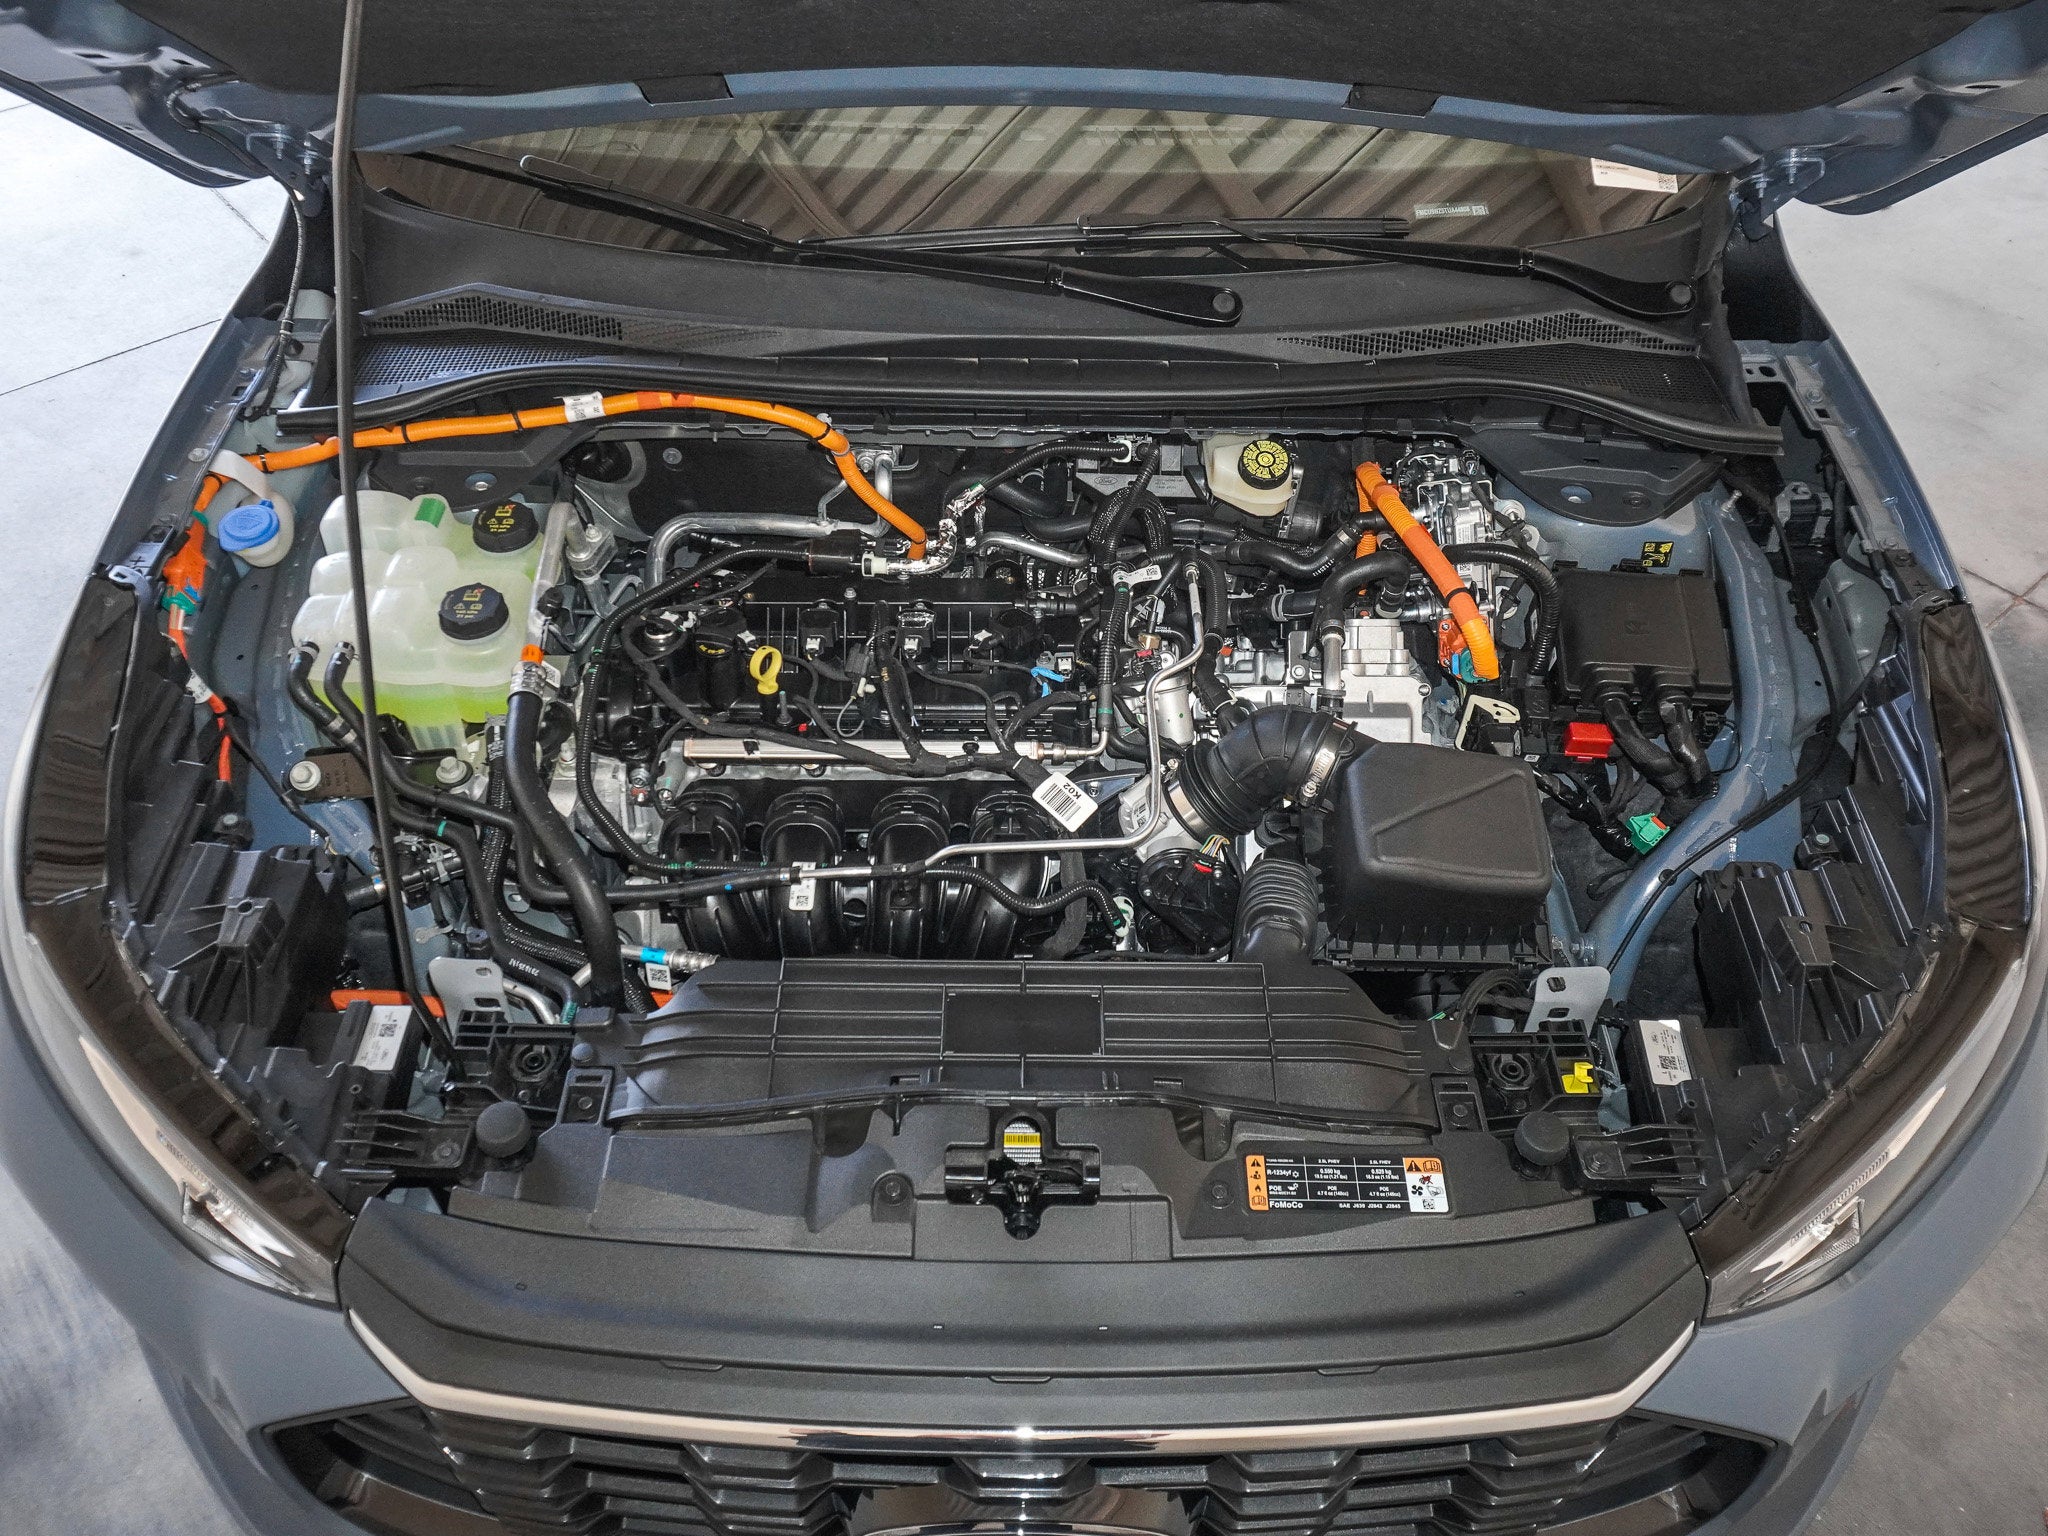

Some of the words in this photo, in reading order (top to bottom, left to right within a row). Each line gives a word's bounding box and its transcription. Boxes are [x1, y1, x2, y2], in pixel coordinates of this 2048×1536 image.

[1063, 782, 1082, 800] K02
[1266, 1169, 1292, 1177] R-1234yf
[1333, 1168, 1341, 1176] kg
[1269, 1200, 1304, 1209] FoMoCo
